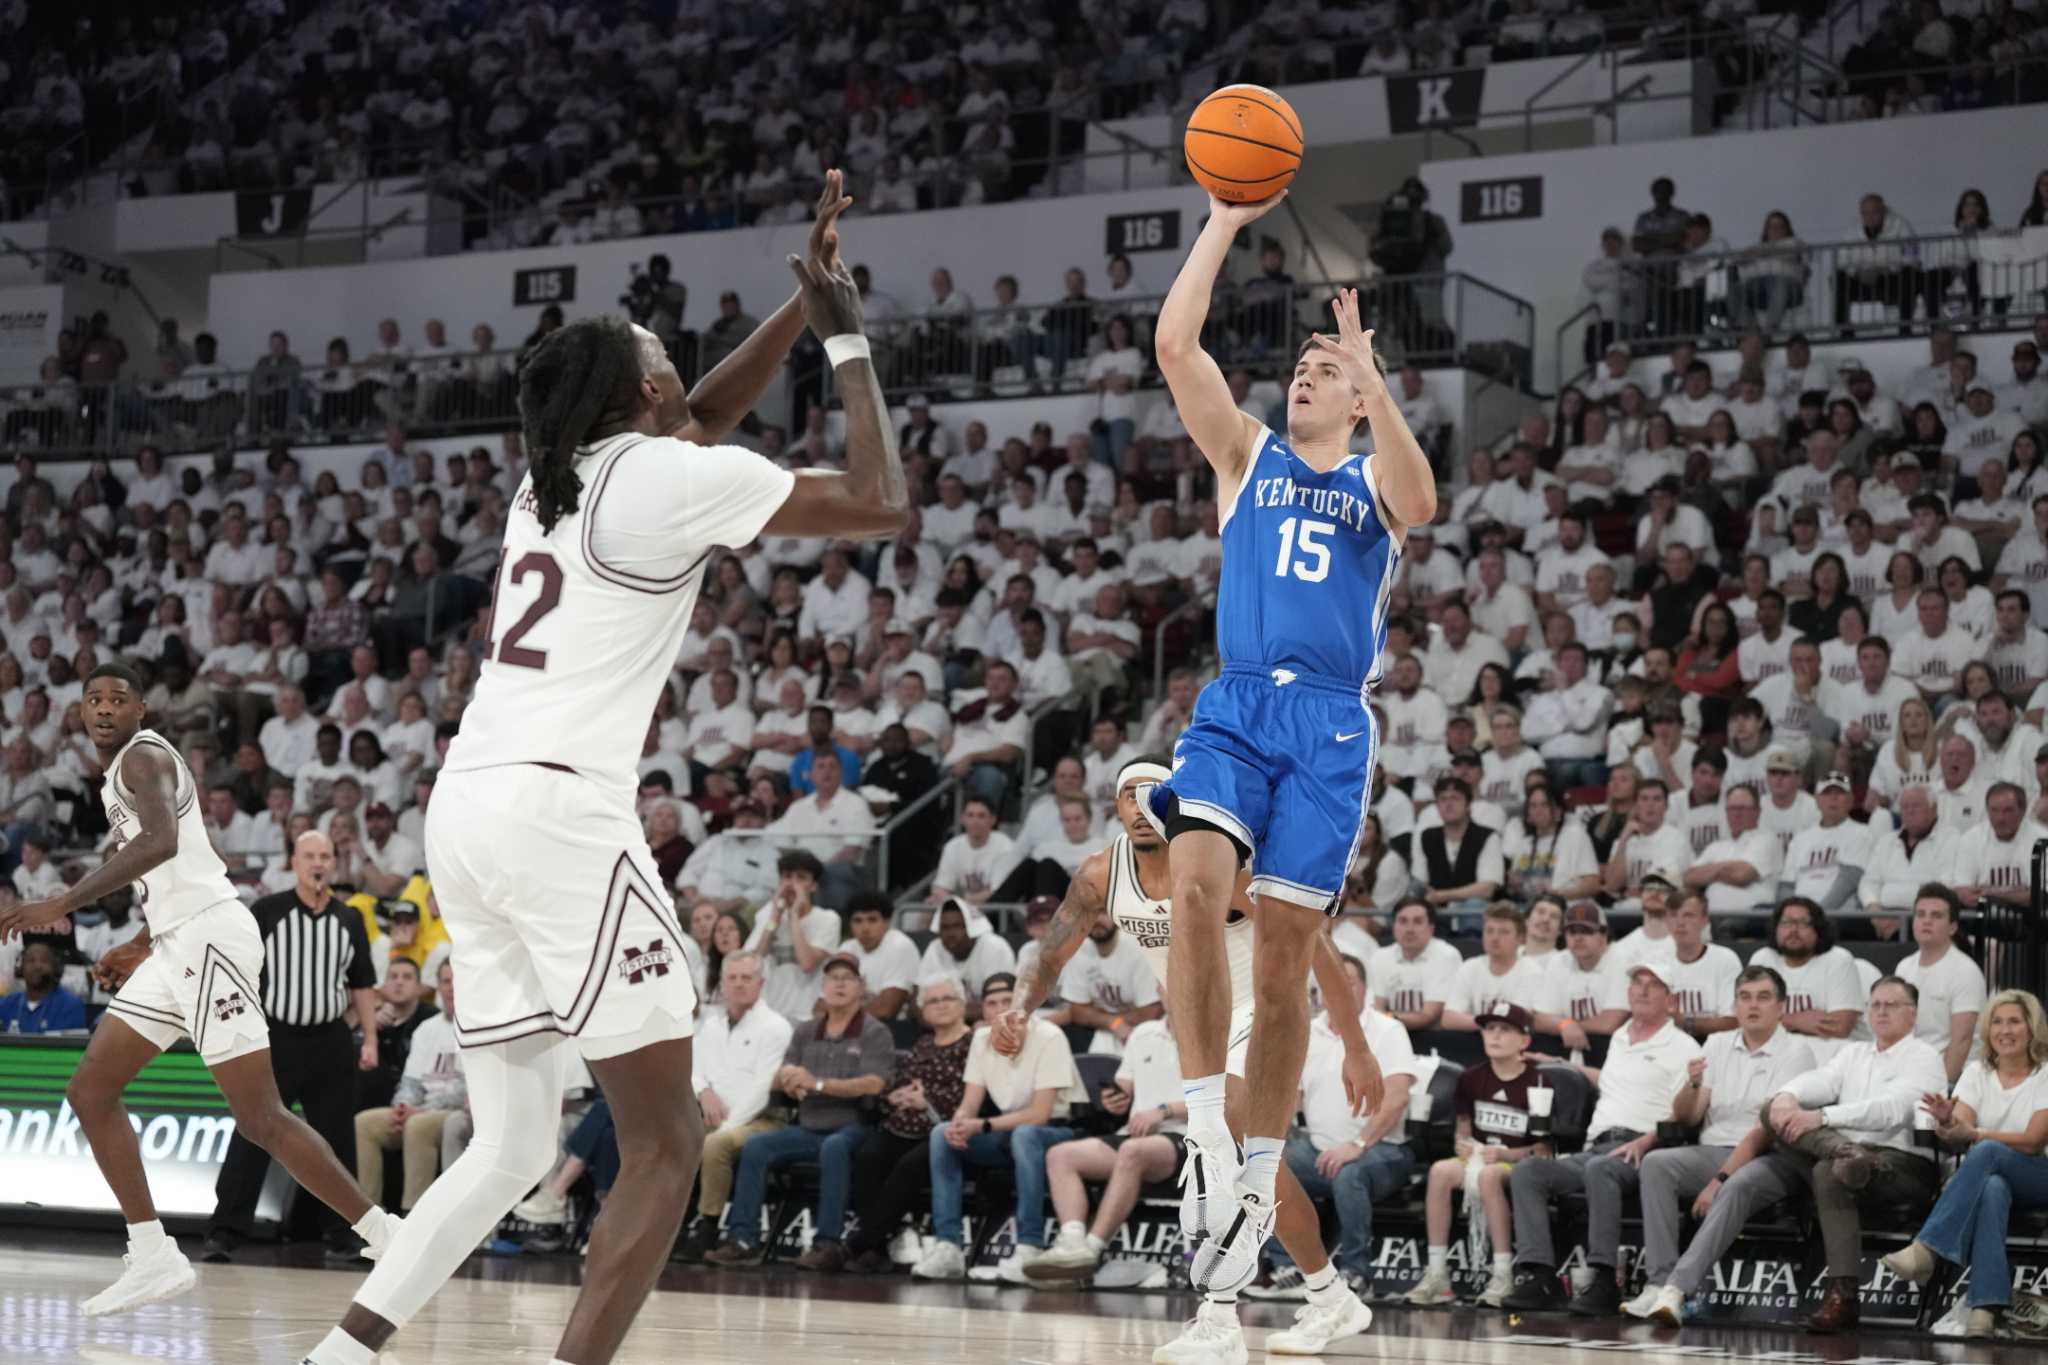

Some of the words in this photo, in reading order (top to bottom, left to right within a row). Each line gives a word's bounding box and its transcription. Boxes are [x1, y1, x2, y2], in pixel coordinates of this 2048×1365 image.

[1417, 77, 1452, 124] K
[261, 195, 285, 233] J
[1479, 184, 1523, 216] 116
[1123, 217, 1163, 248] 116
[529, 271, 562, 300] 115
[1255, 477, 1369, 532] KENTUCKY
[1275, 517, 1336, 583] 15
[628, 952, 664, 971] STATE
[1477, 1110, 1520, 1129] STATE
[1704, 1259, 1798, 1294] ALFA
